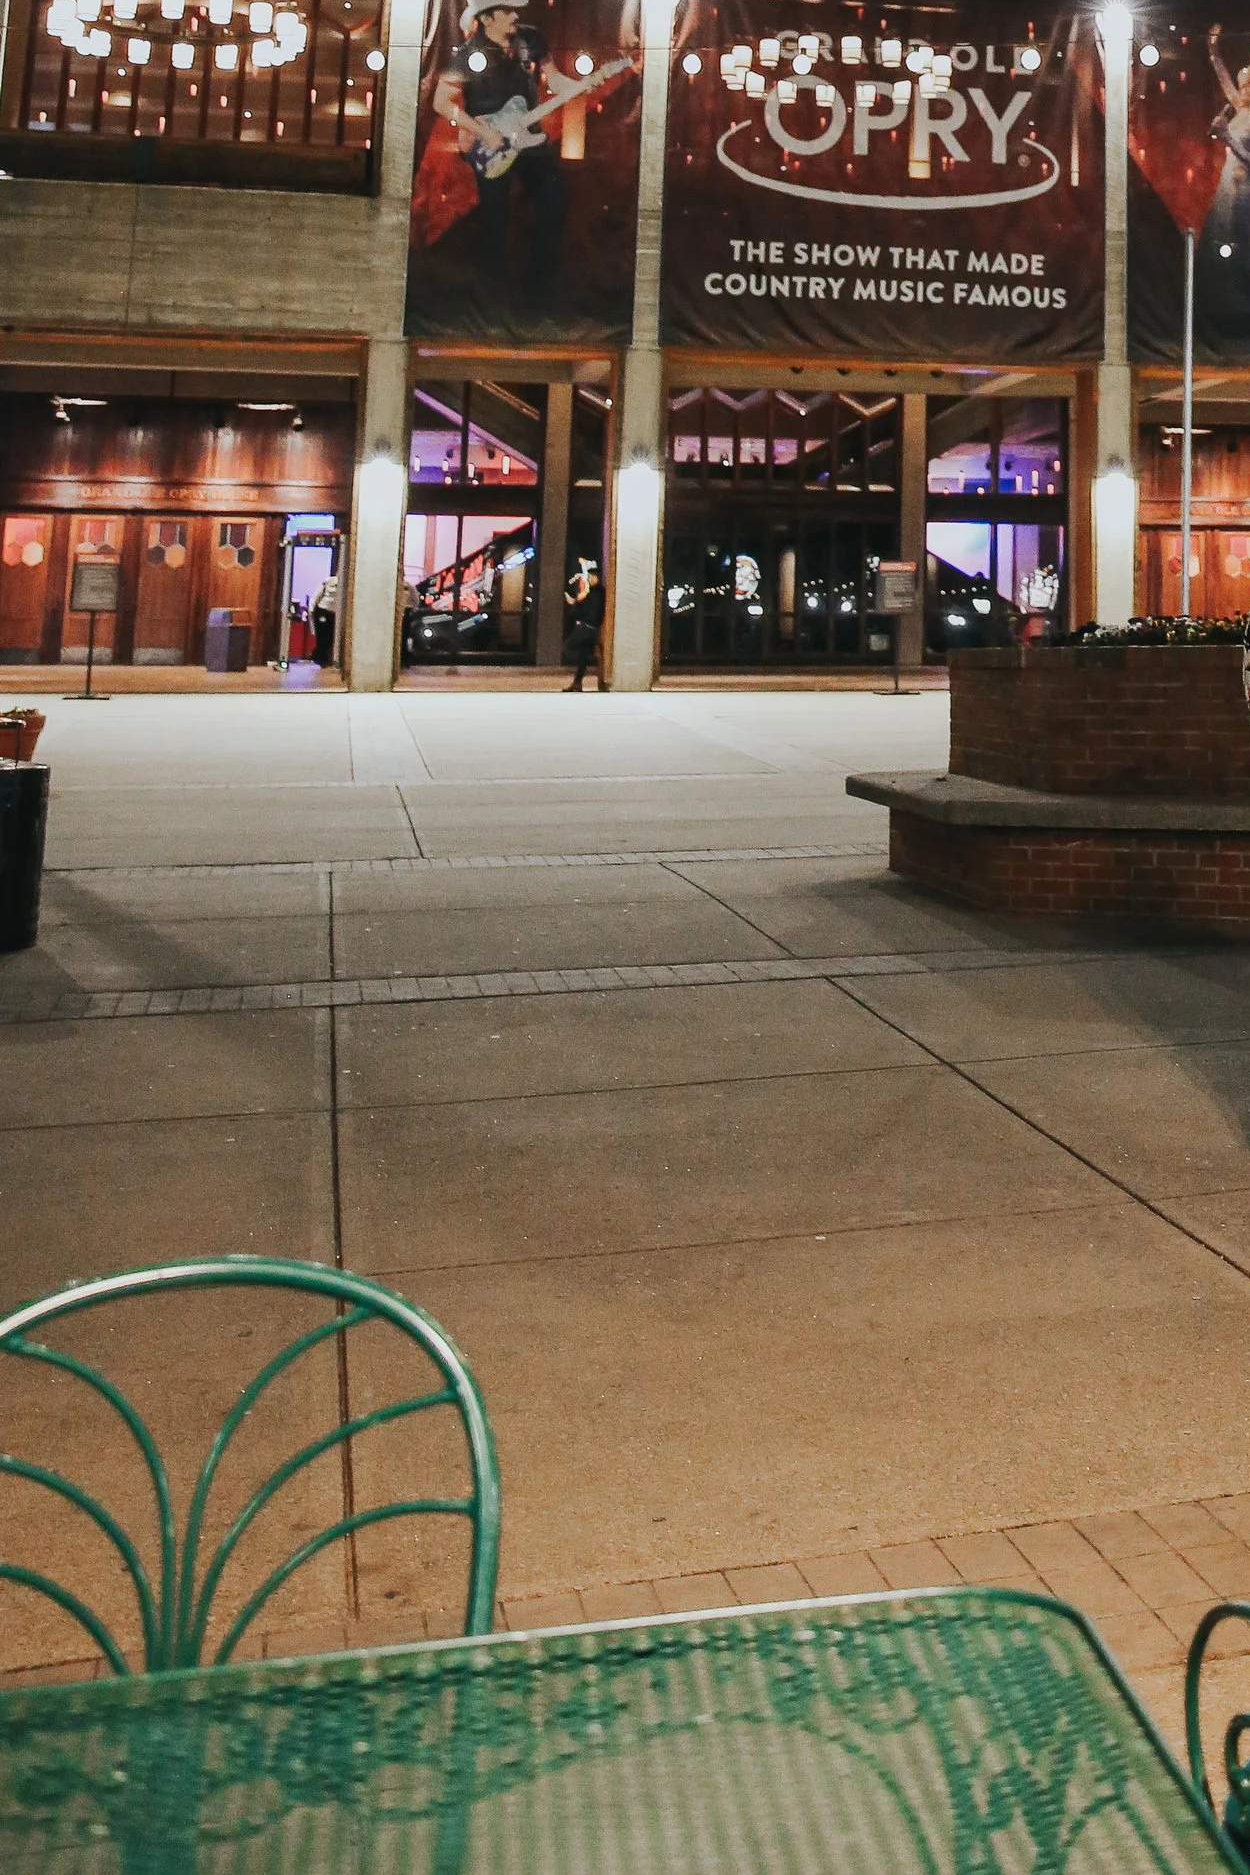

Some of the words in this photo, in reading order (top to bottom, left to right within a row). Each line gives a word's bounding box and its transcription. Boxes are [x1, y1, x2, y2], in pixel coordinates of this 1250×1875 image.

[764, 74, 1033, 165] OPRY
[729, 239, 785, 264] THE
[793, 242, 881, 268] SHOW
[888, 246, 960, 272] THAT
[966, 250, 1045, 276] MADE
[703, 272, 845, 300] COUNTRY
[852, 278, 945, 304] MUSIC
[953, 282, 1067, 310] FAMOUS
